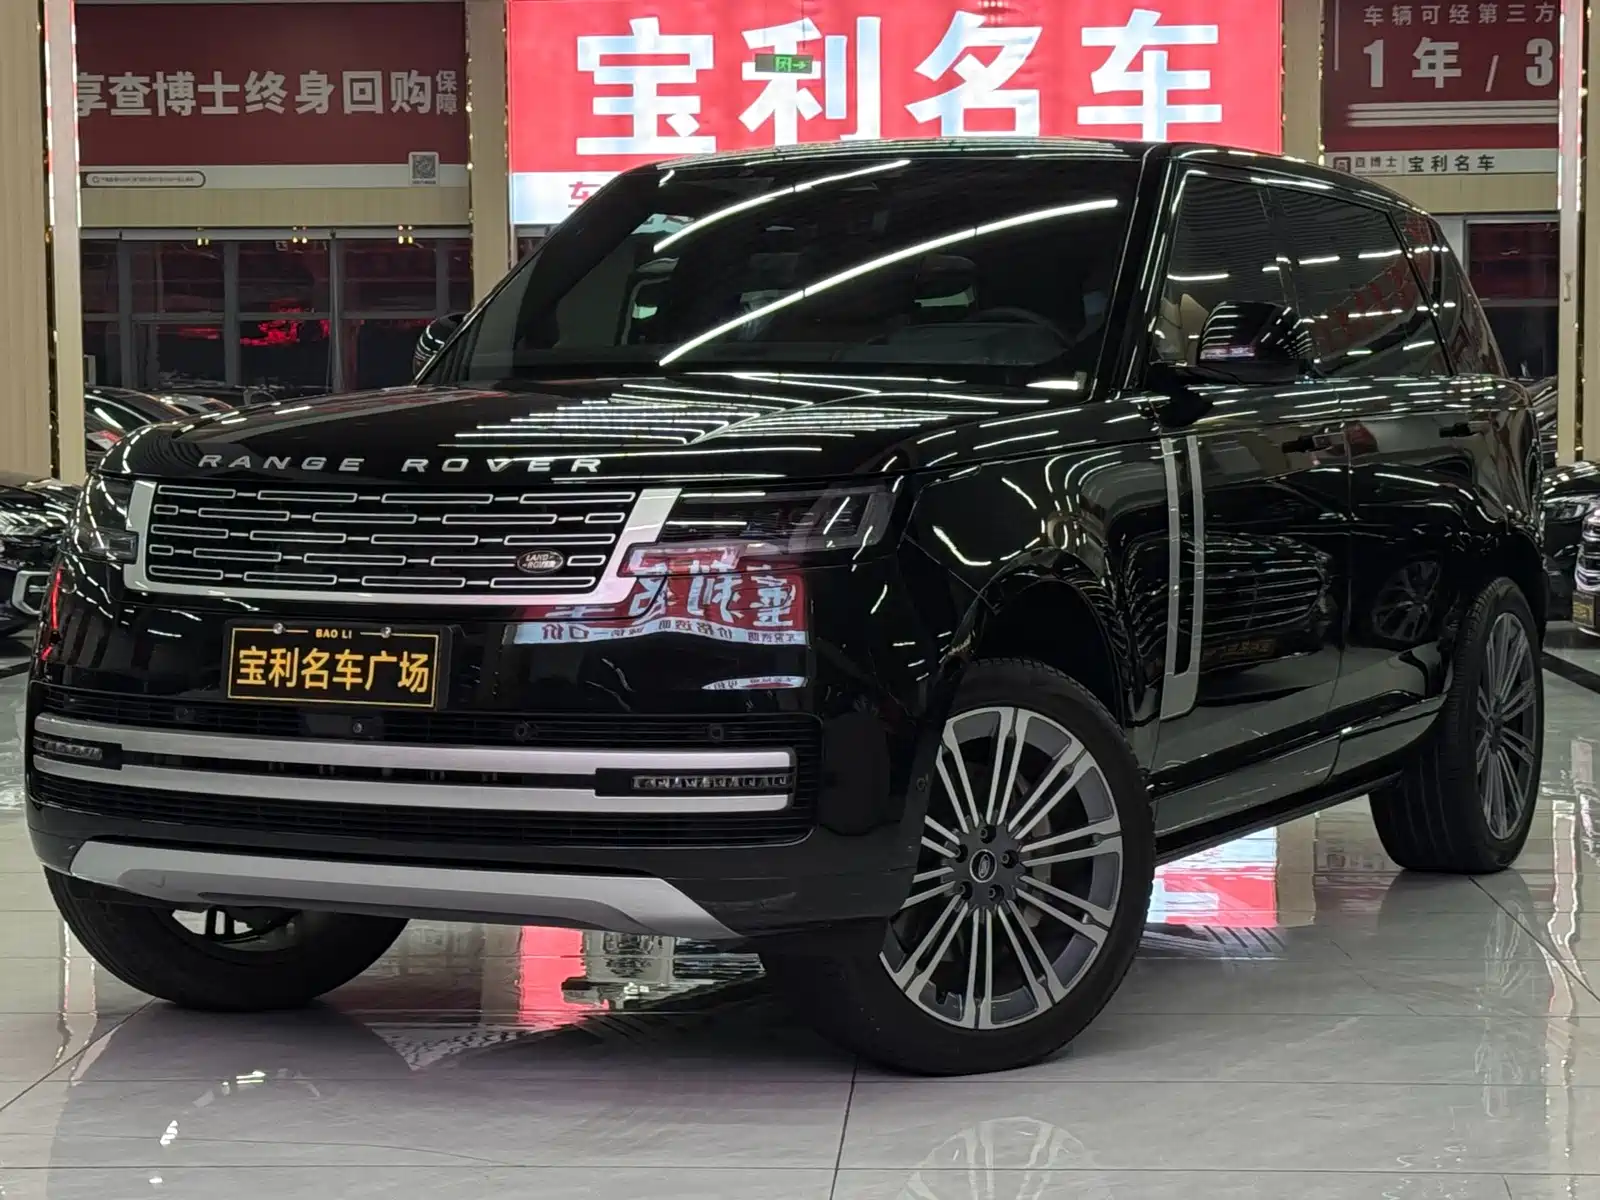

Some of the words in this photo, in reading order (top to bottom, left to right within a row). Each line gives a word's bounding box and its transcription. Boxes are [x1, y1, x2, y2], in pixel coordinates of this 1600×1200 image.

[1364, 4, 1555, 26] 车辆可经第三方
[576, 8, 1222, 155] 宝利名车
[1408, 155, 1495, 172] 宝利名车
[198, 455, 366, 472] RANGE
[402, 457, 603, 473] ROVER
[525, 553, 549, 562] LAND
[315, 629, 339, 639] BAO
[342, 630, 353, 639] LI
[236, 645, 430, 693] 宝利名车广场
